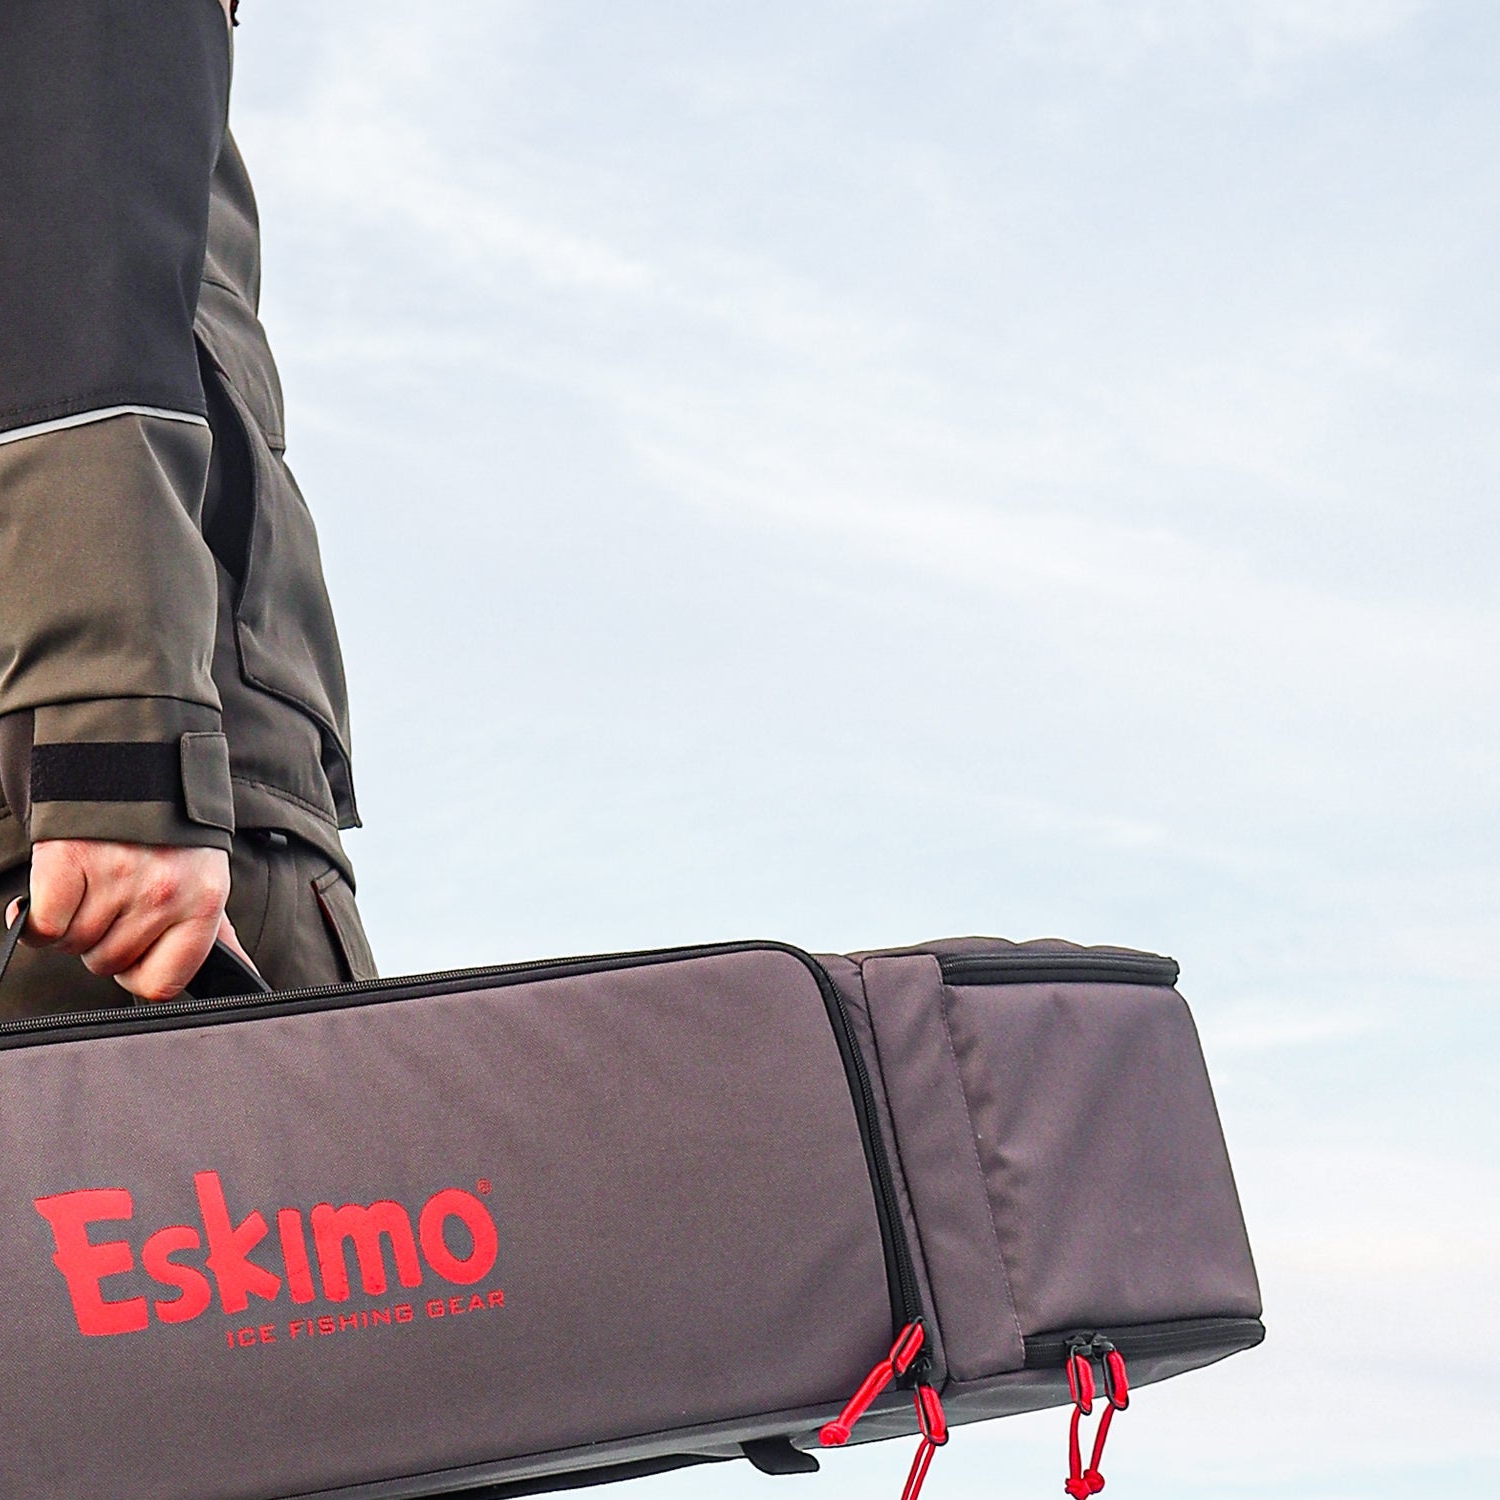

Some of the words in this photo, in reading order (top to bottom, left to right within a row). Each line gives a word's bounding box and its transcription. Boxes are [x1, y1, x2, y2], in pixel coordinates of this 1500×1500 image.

[226, 1323, 277, 1349] ICE
[288, 1302, 415, 1340] FISHING
[424, 1289, 505, 1319] GEAR
